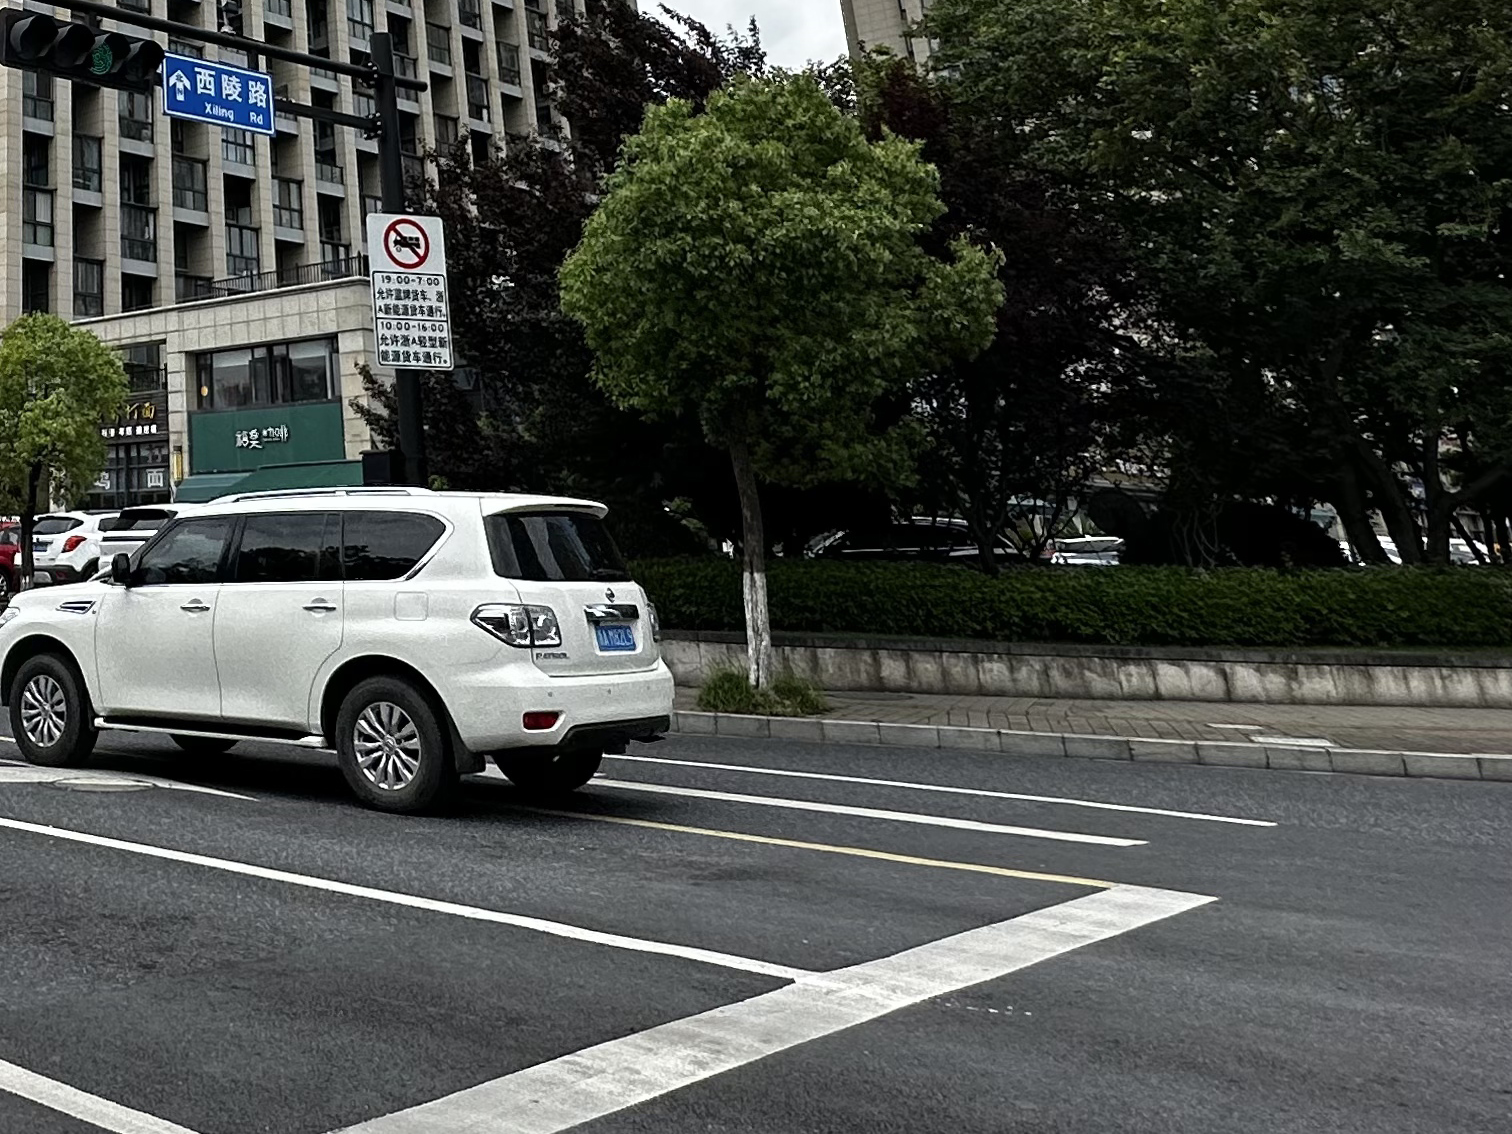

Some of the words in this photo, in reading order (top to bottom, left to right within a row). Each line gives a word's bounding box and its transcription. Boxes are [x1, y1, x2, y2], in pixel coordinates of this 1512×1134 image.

[194, 67, 267, 108] 西陵路
[204, 101, 234, 121] Xiling
[250, 112, 264, 125] Rd
[381, 274, 440, 286] 19:00-7:00
[380, 321, 445, 333] 10:00-16:00
